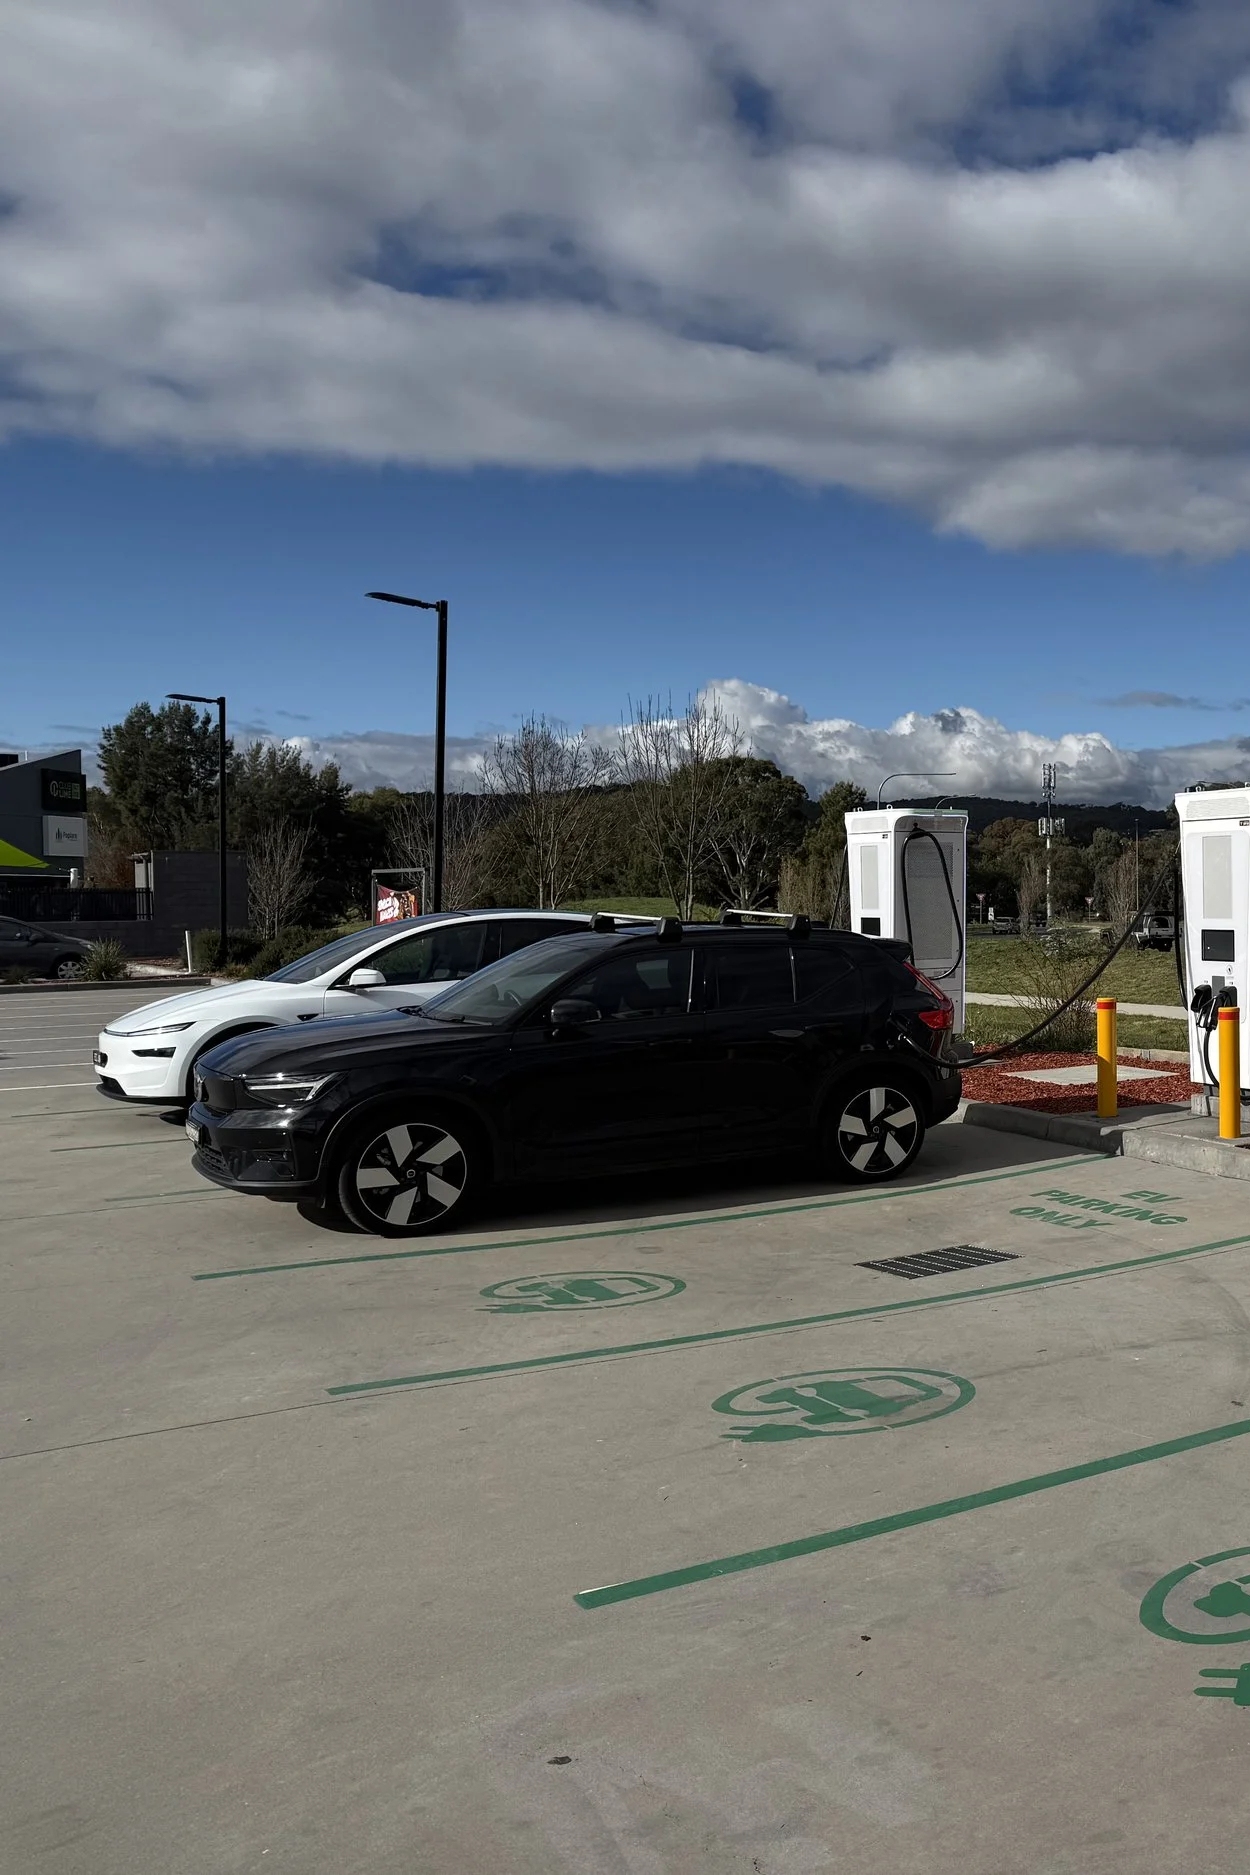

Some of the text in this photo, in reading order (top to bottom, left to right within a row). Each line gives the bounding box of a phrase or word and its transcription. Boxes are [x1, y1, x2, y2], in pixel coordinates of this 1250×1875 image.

[1028, 1188, 1188, 1226] PARKING
[1120, 1190, 1184, 1205] EV
[1009, 1206, 1116, 1230] ONLY
